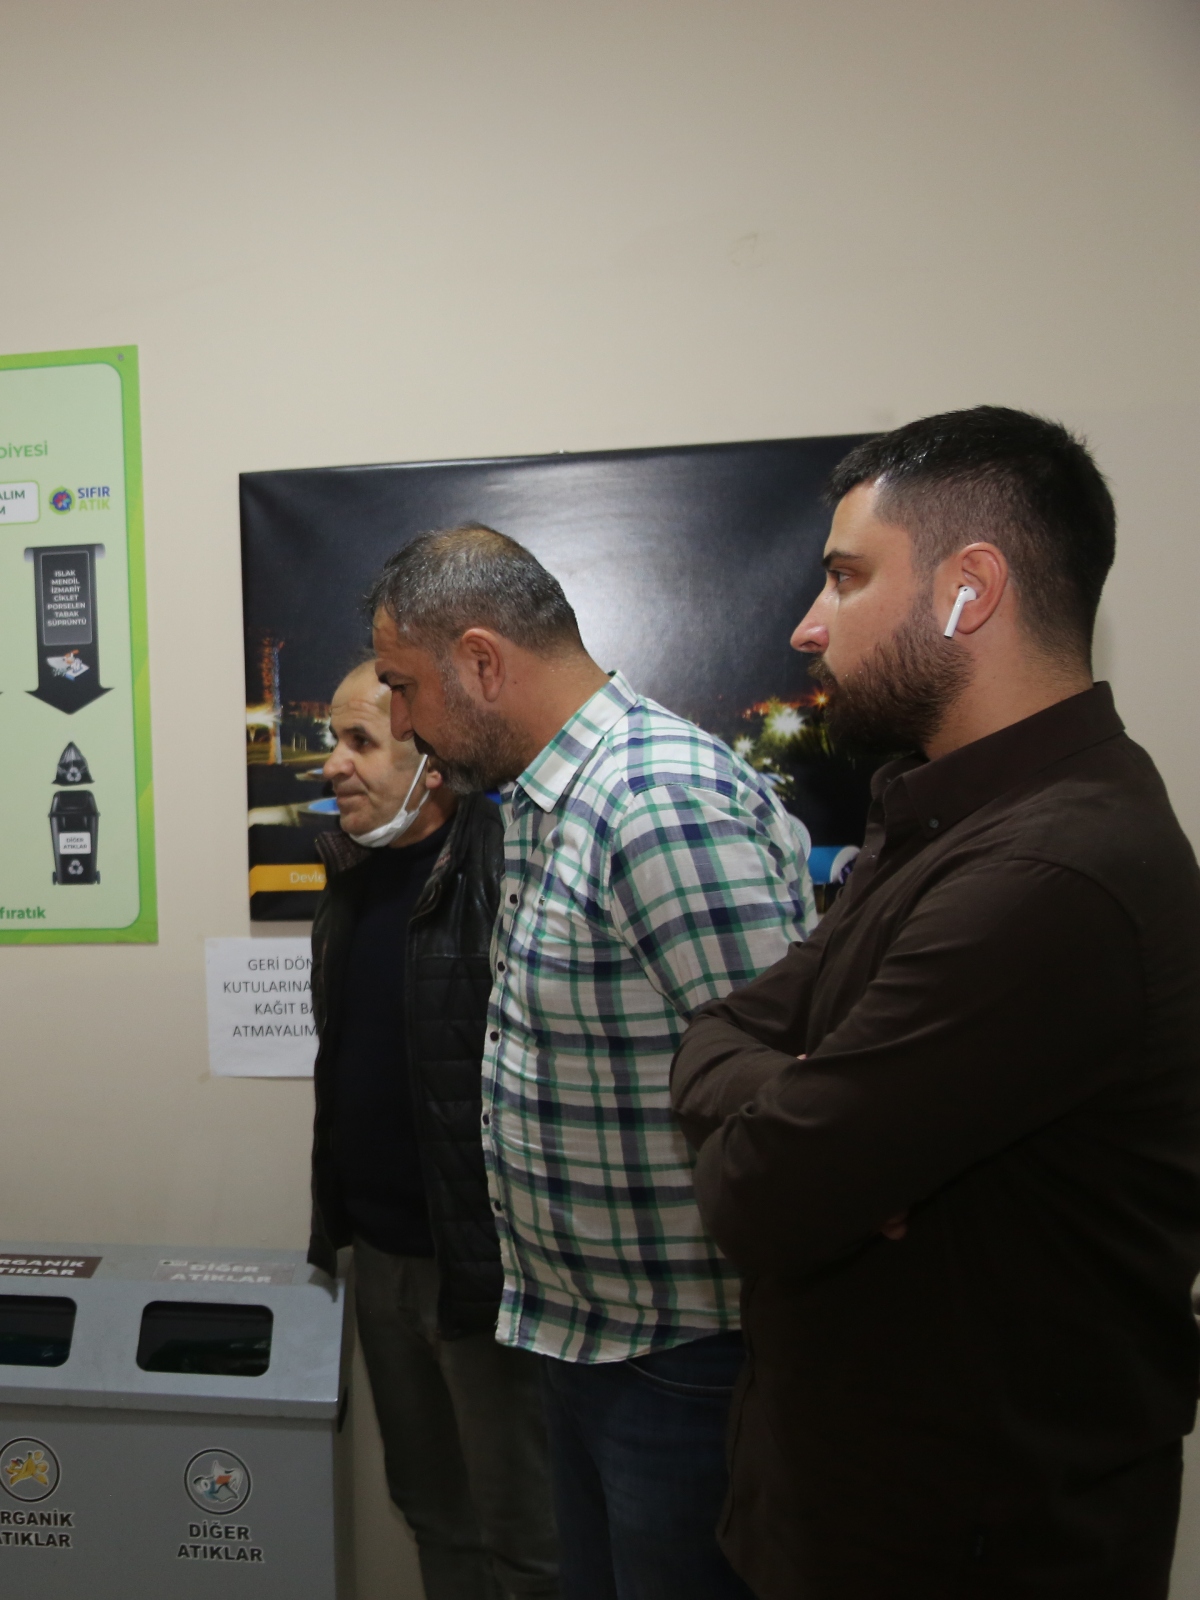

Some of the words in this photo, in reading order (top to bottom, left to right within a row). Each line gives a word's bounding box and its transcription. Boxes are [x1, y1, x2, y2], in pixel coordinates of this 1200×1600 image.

[77, 486, 110, 498] SIFIR
[78, 498, 110, 511] ATIK
[51, 577, 80, 586] MENDİL
[51, 585, 81, 594] İZMARİT
[47, 602, 86, 610] PORSELEN
[55, 610, 79, 618] TABAK
[47, 617, 87, 626] SÜPRÜNTÜ
[290, 871, 326, 883] Devle
[248, 956, 279, 971] GERİ
[284, 955, 312, 970] DÖN
[223, 981, 312, 993] KUTULARINA
[255, 1000, 296, 1015] KAĞIT
[232, 1024, 318, 1037] ATMAYALIM
[187, 1520, 252, 1541] DİĞER
[176, 1543, 265, 1563] ATIKLAR
